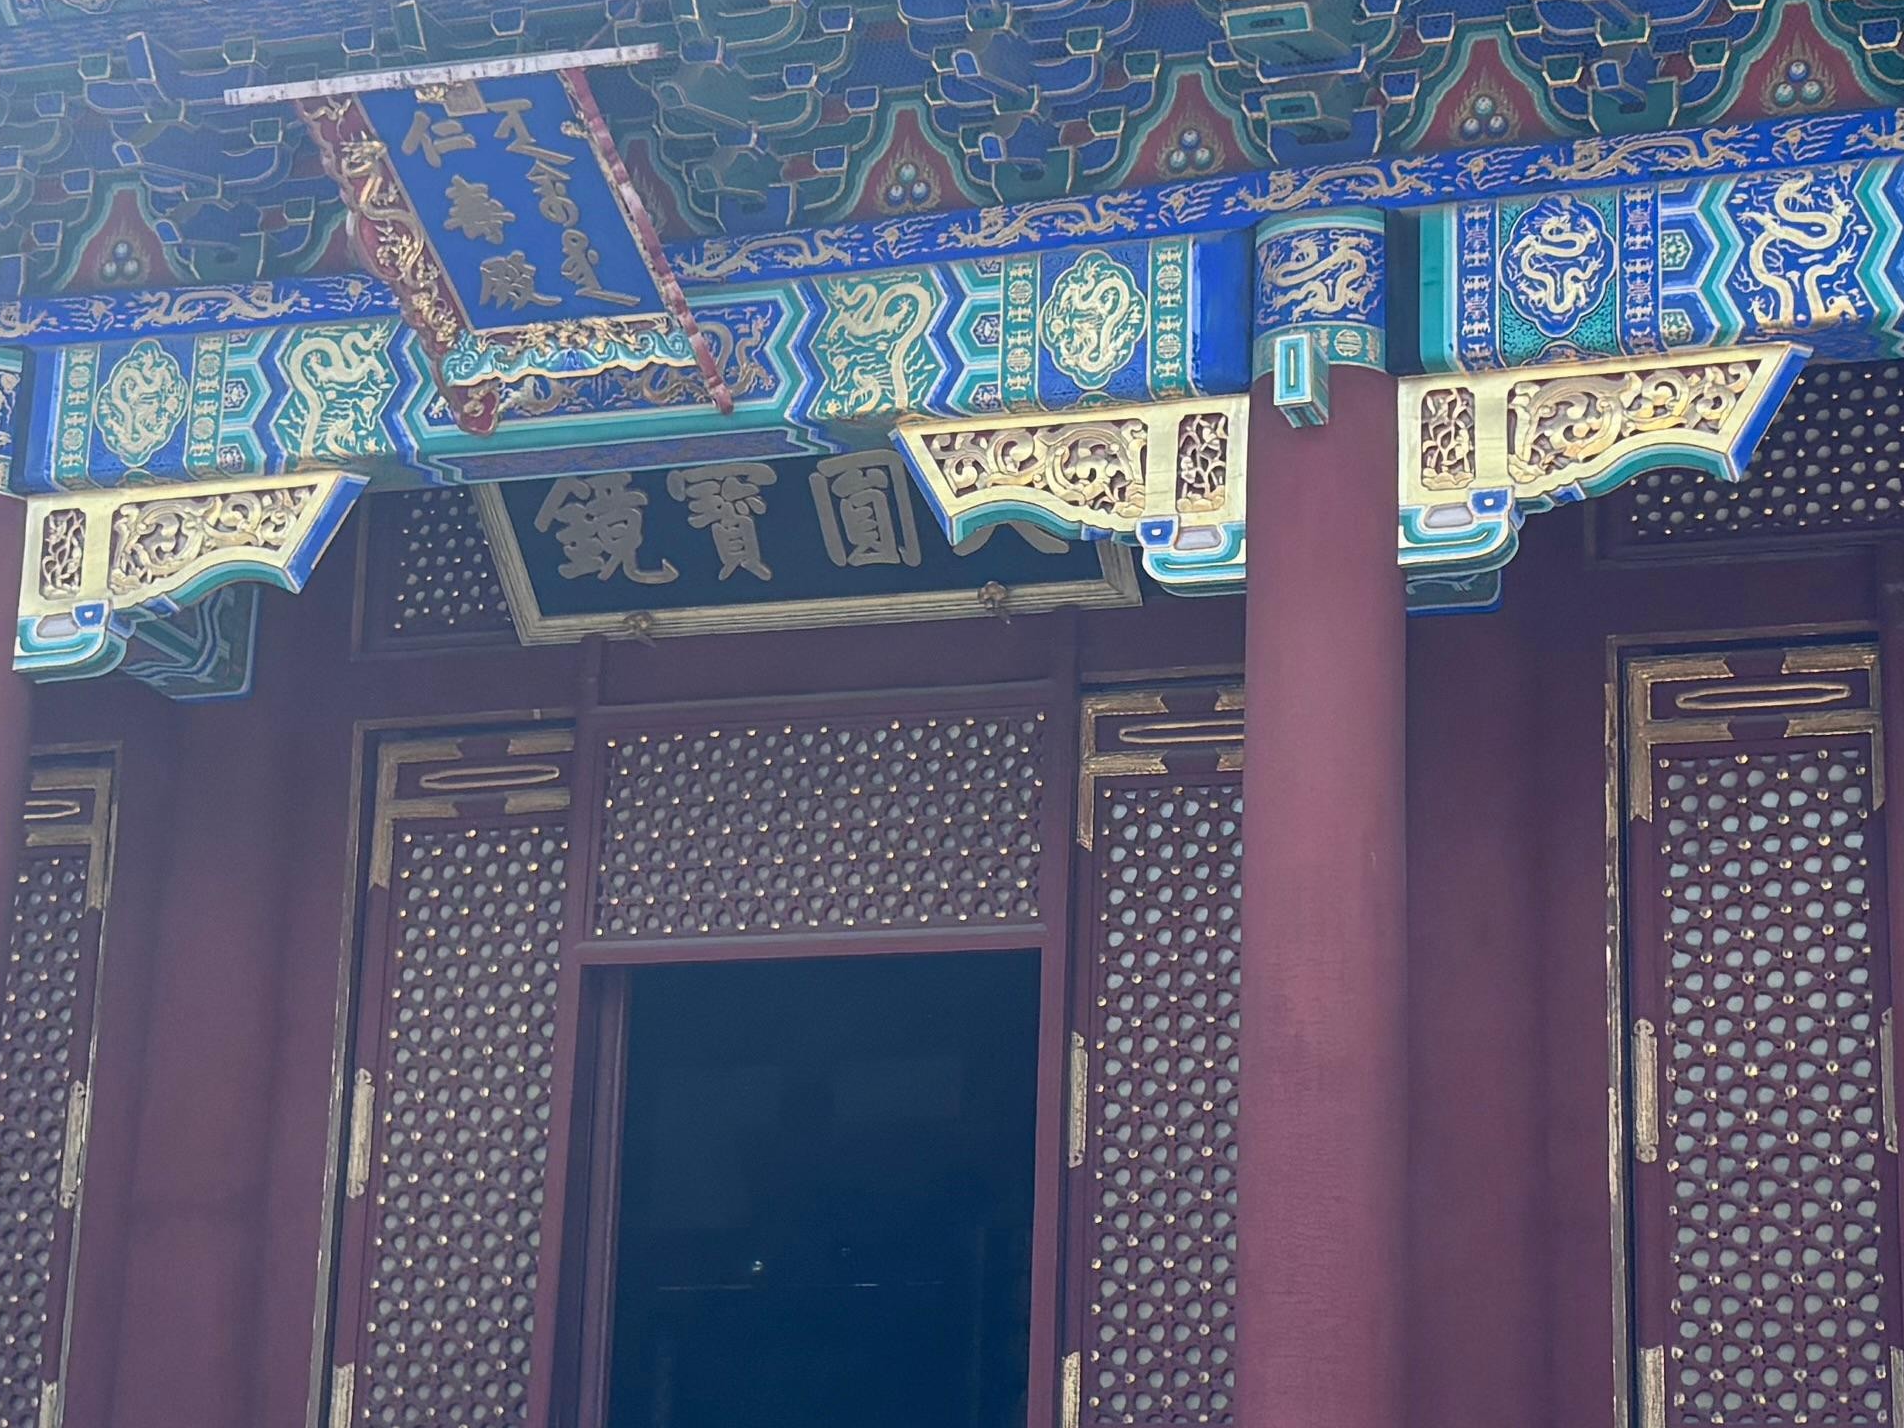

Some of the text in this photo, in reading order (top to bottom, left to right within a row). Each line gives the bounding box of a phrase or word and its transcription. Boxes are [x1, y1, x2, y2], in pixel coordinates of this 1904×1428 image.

[401, 111, 562, 311] 仁壽殿
[534, 449, 1069, 584] 圓寶鏡
